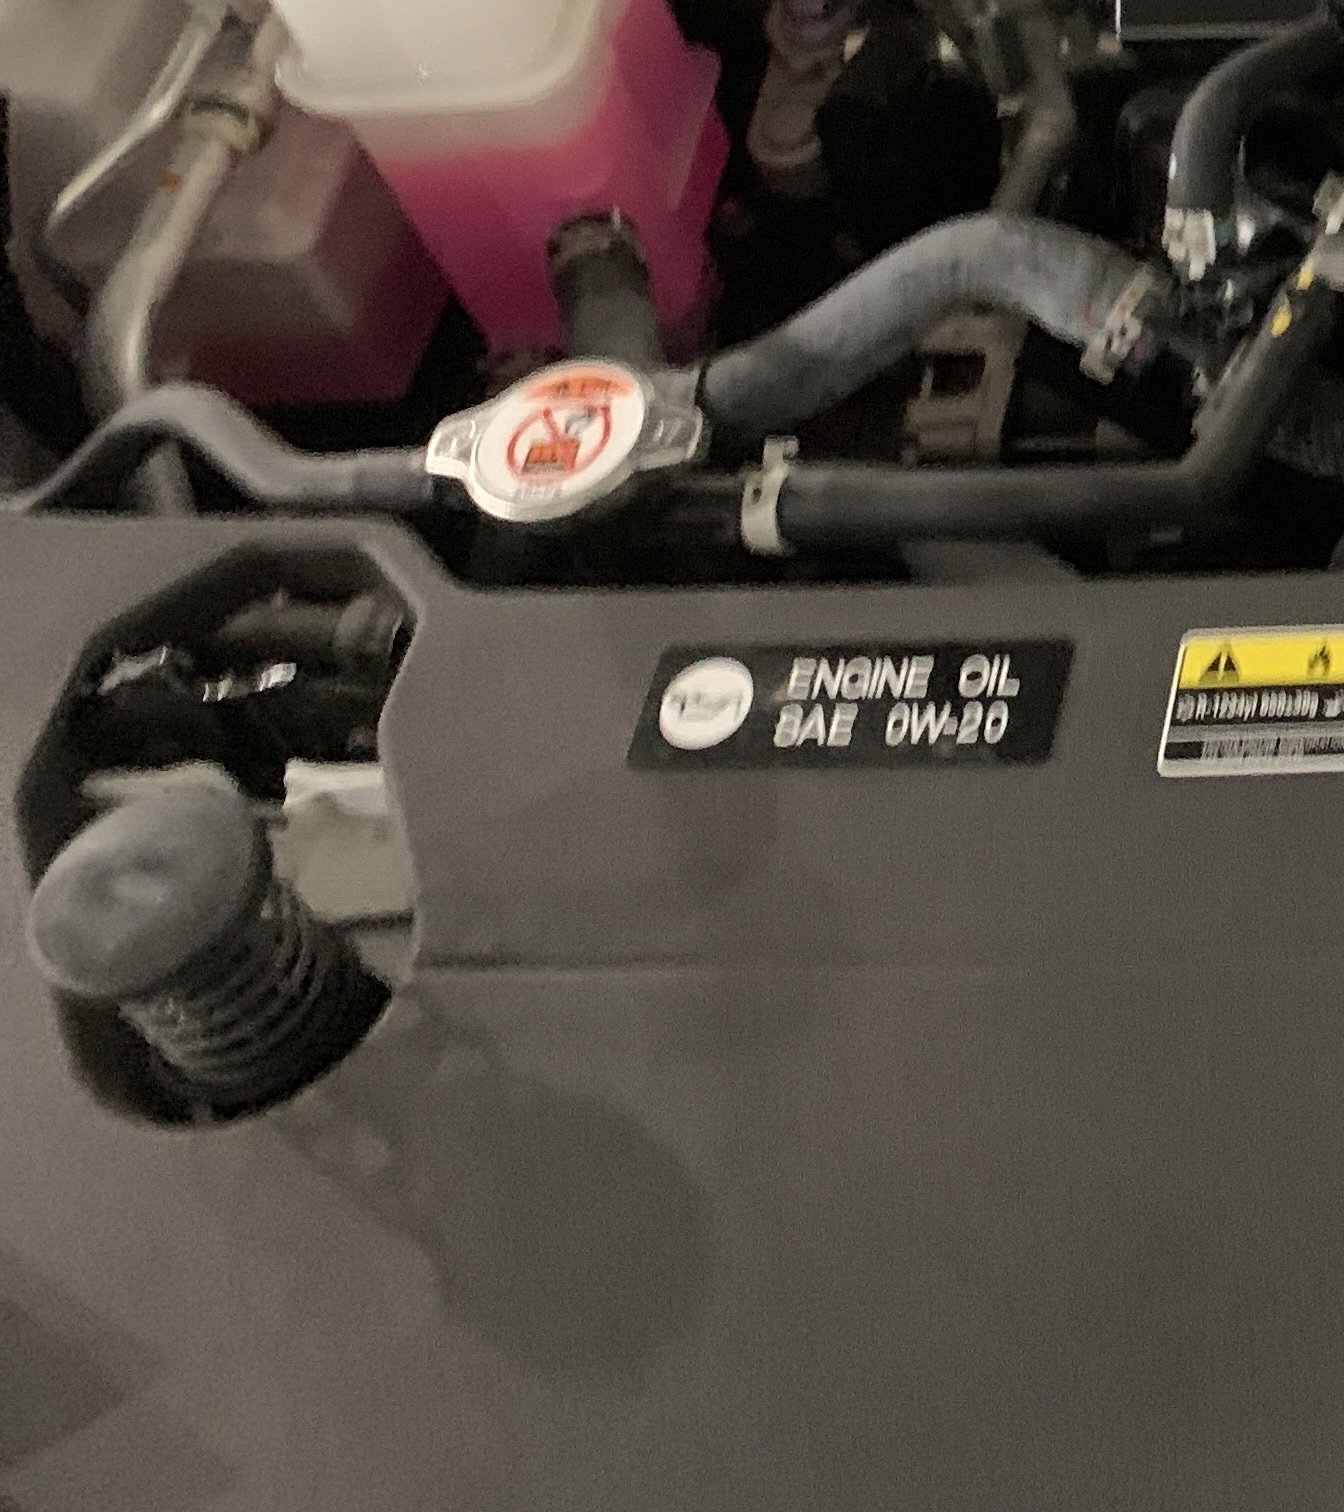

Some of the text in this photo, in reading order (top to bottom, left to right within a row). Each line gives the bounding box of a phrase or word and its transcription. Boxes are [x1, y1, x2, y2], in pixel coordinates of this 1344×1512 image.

[787, 653, 1020, 700] ENGINE OIL
[773, 699, 1009, 748] SAE 0W-20
